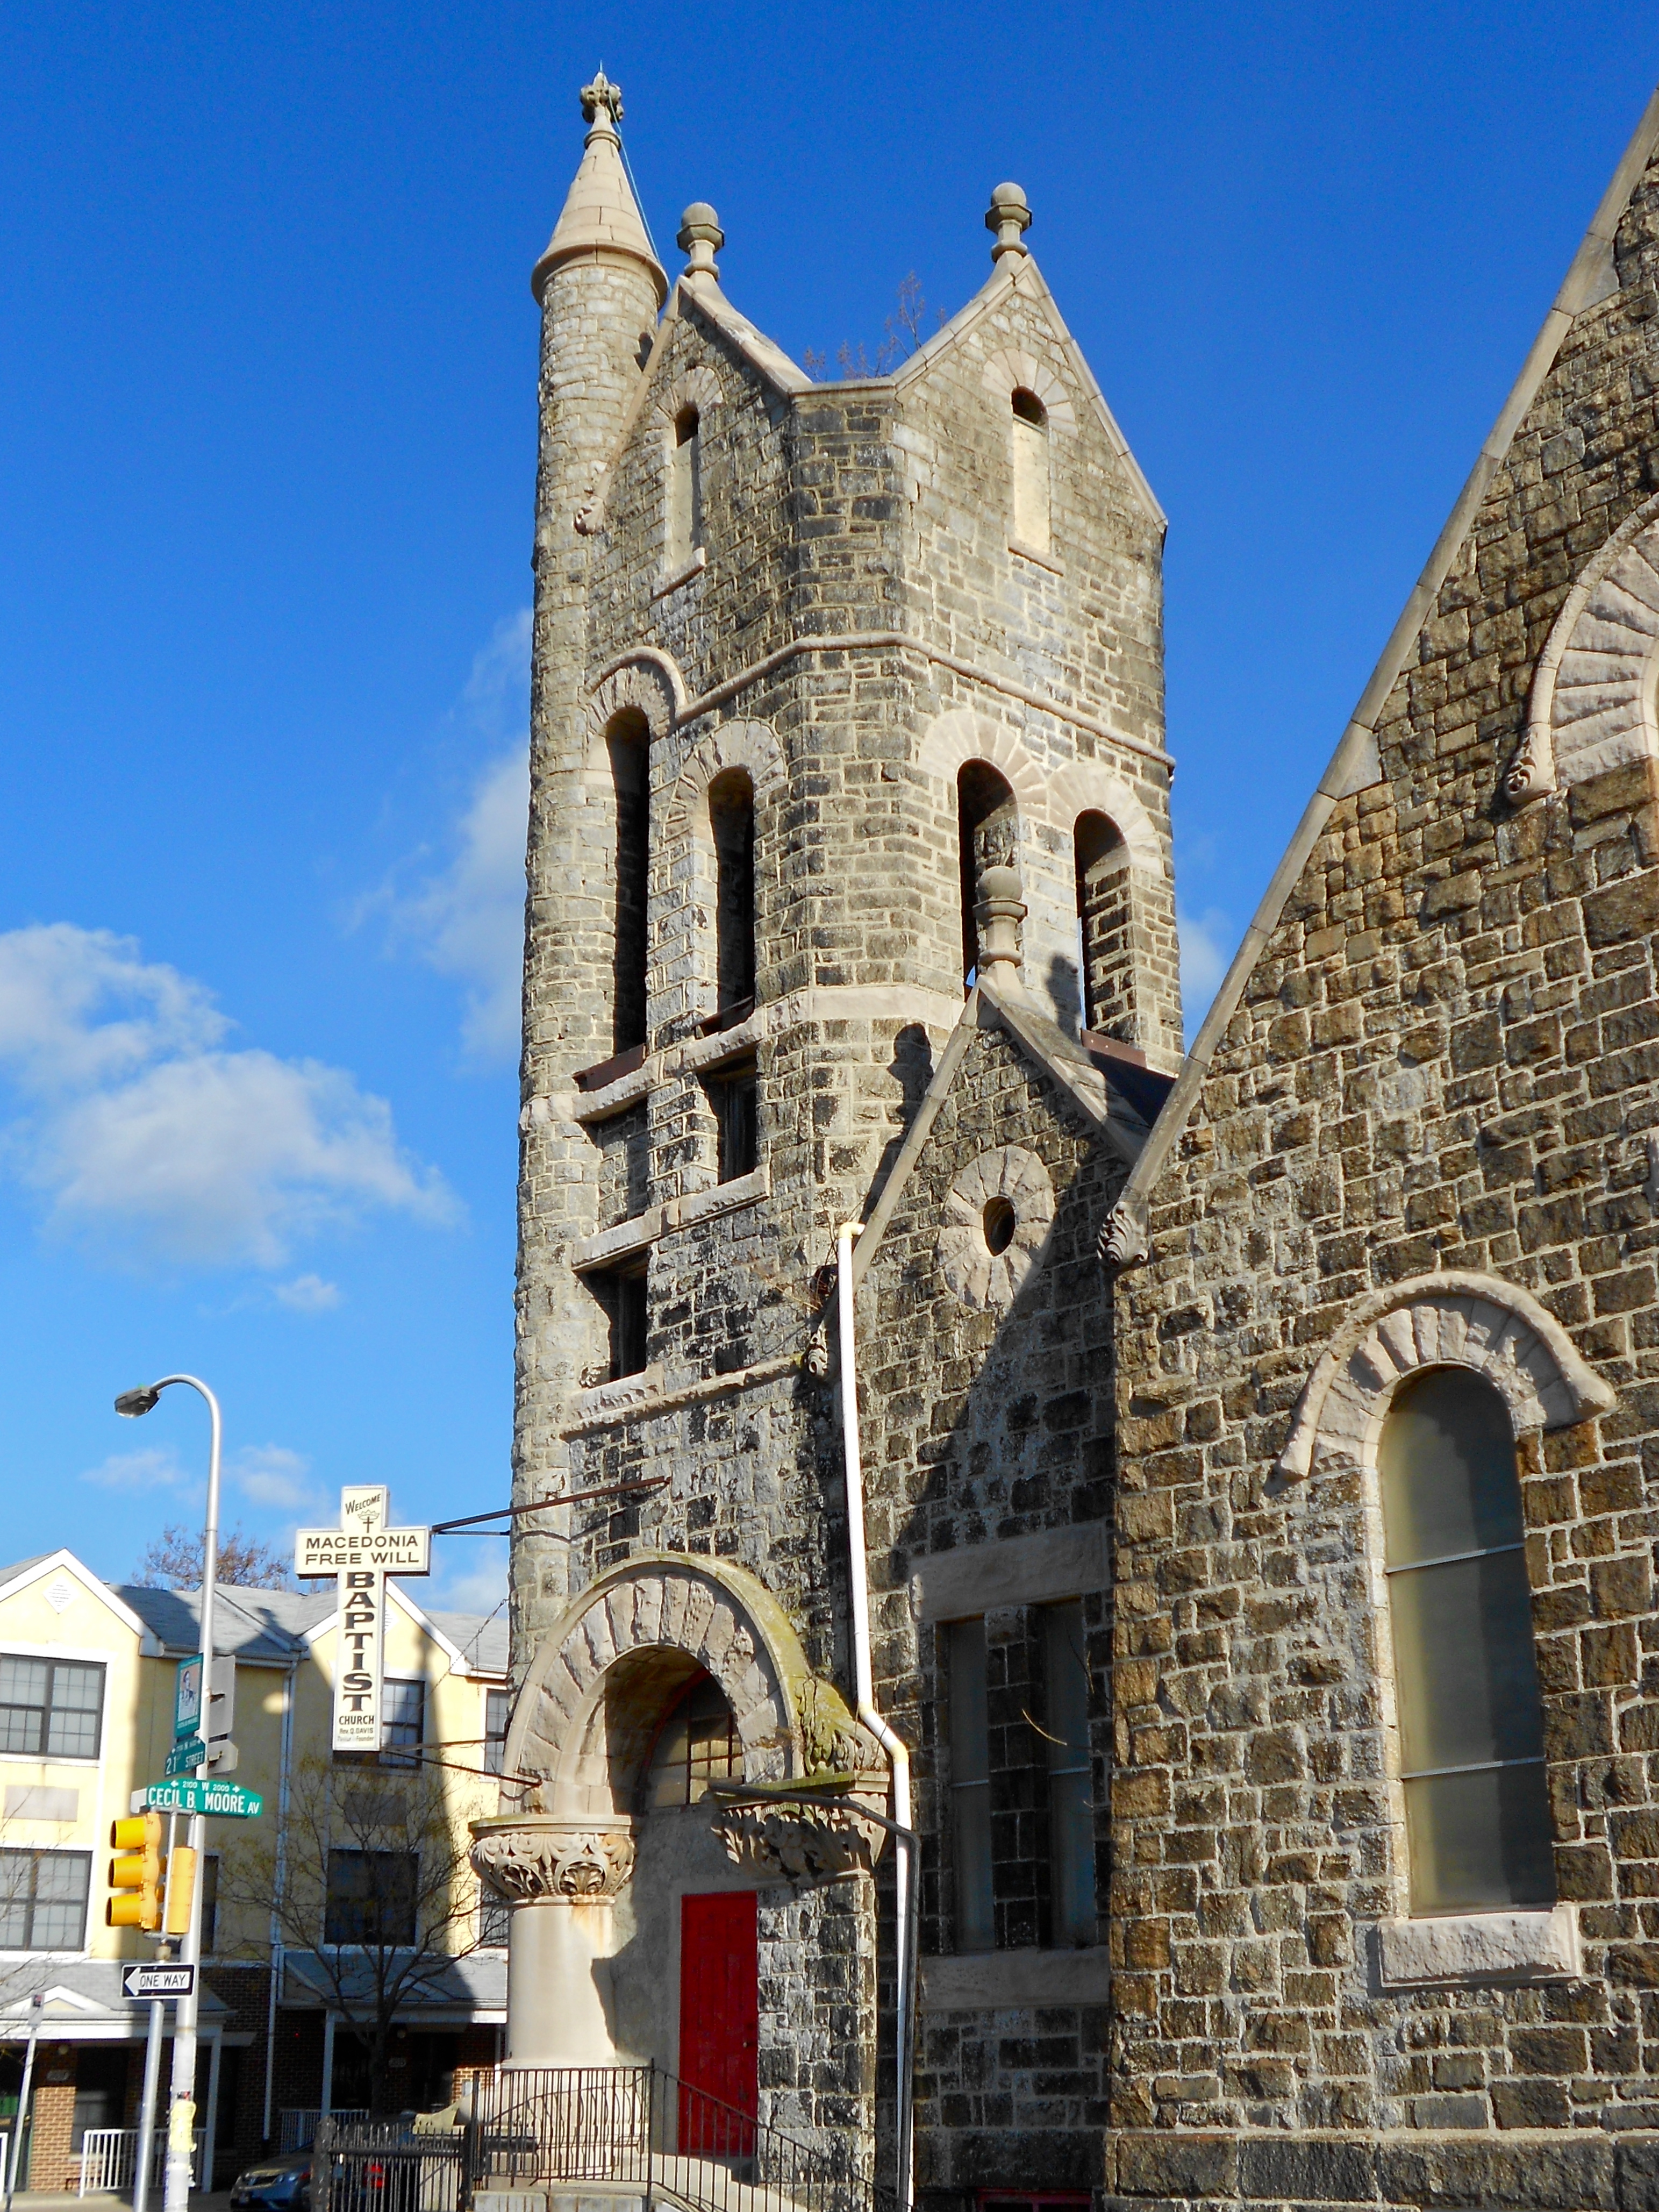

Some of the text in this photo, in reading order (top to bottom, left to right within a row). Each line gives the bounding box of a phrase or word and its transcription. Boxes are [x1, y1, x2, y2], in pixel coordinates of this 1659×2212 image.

[306, 1535, 418, 1549] MACEDONIA
[305, 1552, 419, 1565] FREE WILL
[343, 1571, 376, 1712] BAPTIST
[339, 1715, 375, 1725] CHURCH
[185, 1751, 203, 1768] STREET
[202, 1782, 210, 1791] W
[212, 1784, 230, 1792] 2000
[148, 1787, 260, 1814] CECIL B. MOORE AV
[140, 1974, 187, 1987] ONE WAY
